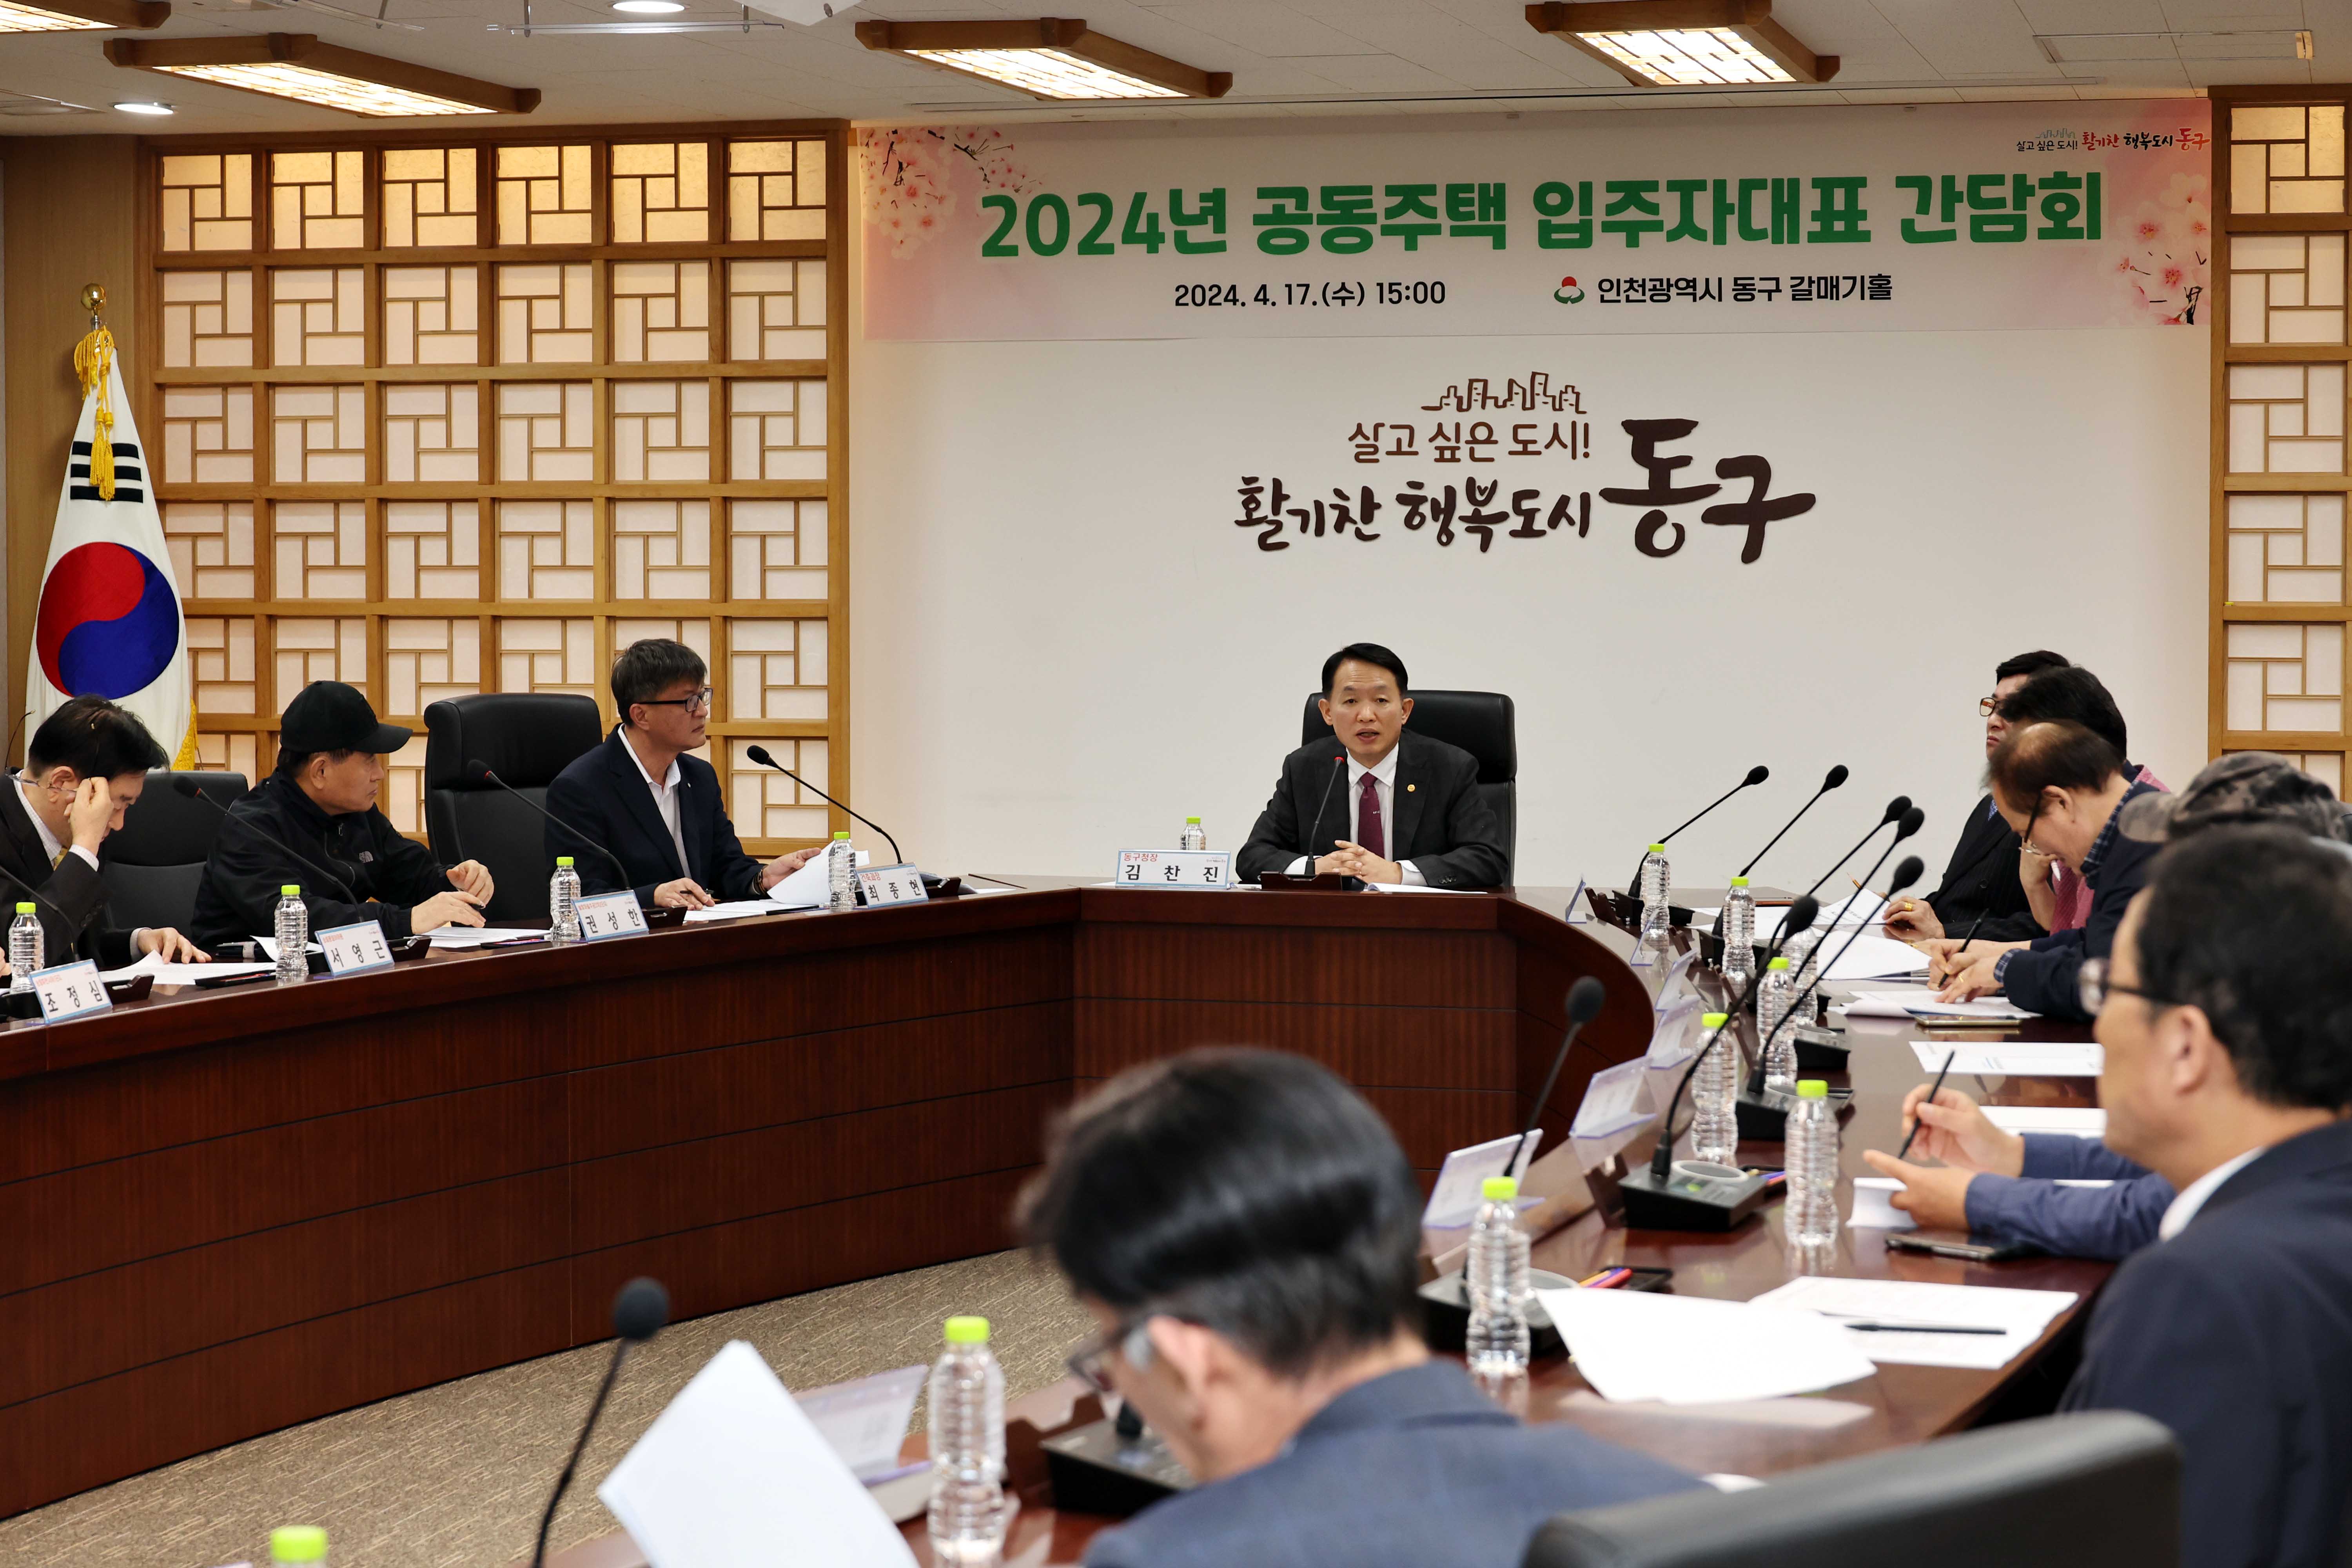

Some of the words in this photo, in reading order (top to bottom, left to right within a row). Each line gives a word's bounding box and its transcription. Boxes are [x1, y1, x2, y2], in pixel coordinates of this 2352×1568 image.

[2016, 141, 2035, 152] 살고
[2036, 140, 2055, 151] 싶은
[2057, 140, 2078, 150] 도시!
[2081, 131, 2120, 151] 활기찬
[2123, 131, 2173, 151] 행복도시
[2176, 127, 2210, 151] 동구
[983, 188, 1227, 256] 2024년
[1253, 183, 1506, 255] 공동주택
[1534, 177, 1871, 249] 입주자대표
[1896, 172, 2100, 243] 간담회
[1175, 284, 1246, 307] 2024.
[1254, 284, 1276, 307] 4.
[1376, 281, 1445, 305] 15:00
[1598, 277, 1722, 303] 인천광역시
[1732, 277, 1782, 302] 동구
[1790, 273, 1893, 301] 갈매기홀
[1348, 422, 1419, 463] 살고
[1428, 421, 1499, 463] 싶은
[1508, 420, 1590, 460] 도시!
[1234, 476, 1382, 552] 활기찬
[1395, 476, 1592, 553] 행복도시
[1599, 418, 1816, 564] 동구
[1123, 853, 1158, 862] 동구청장
